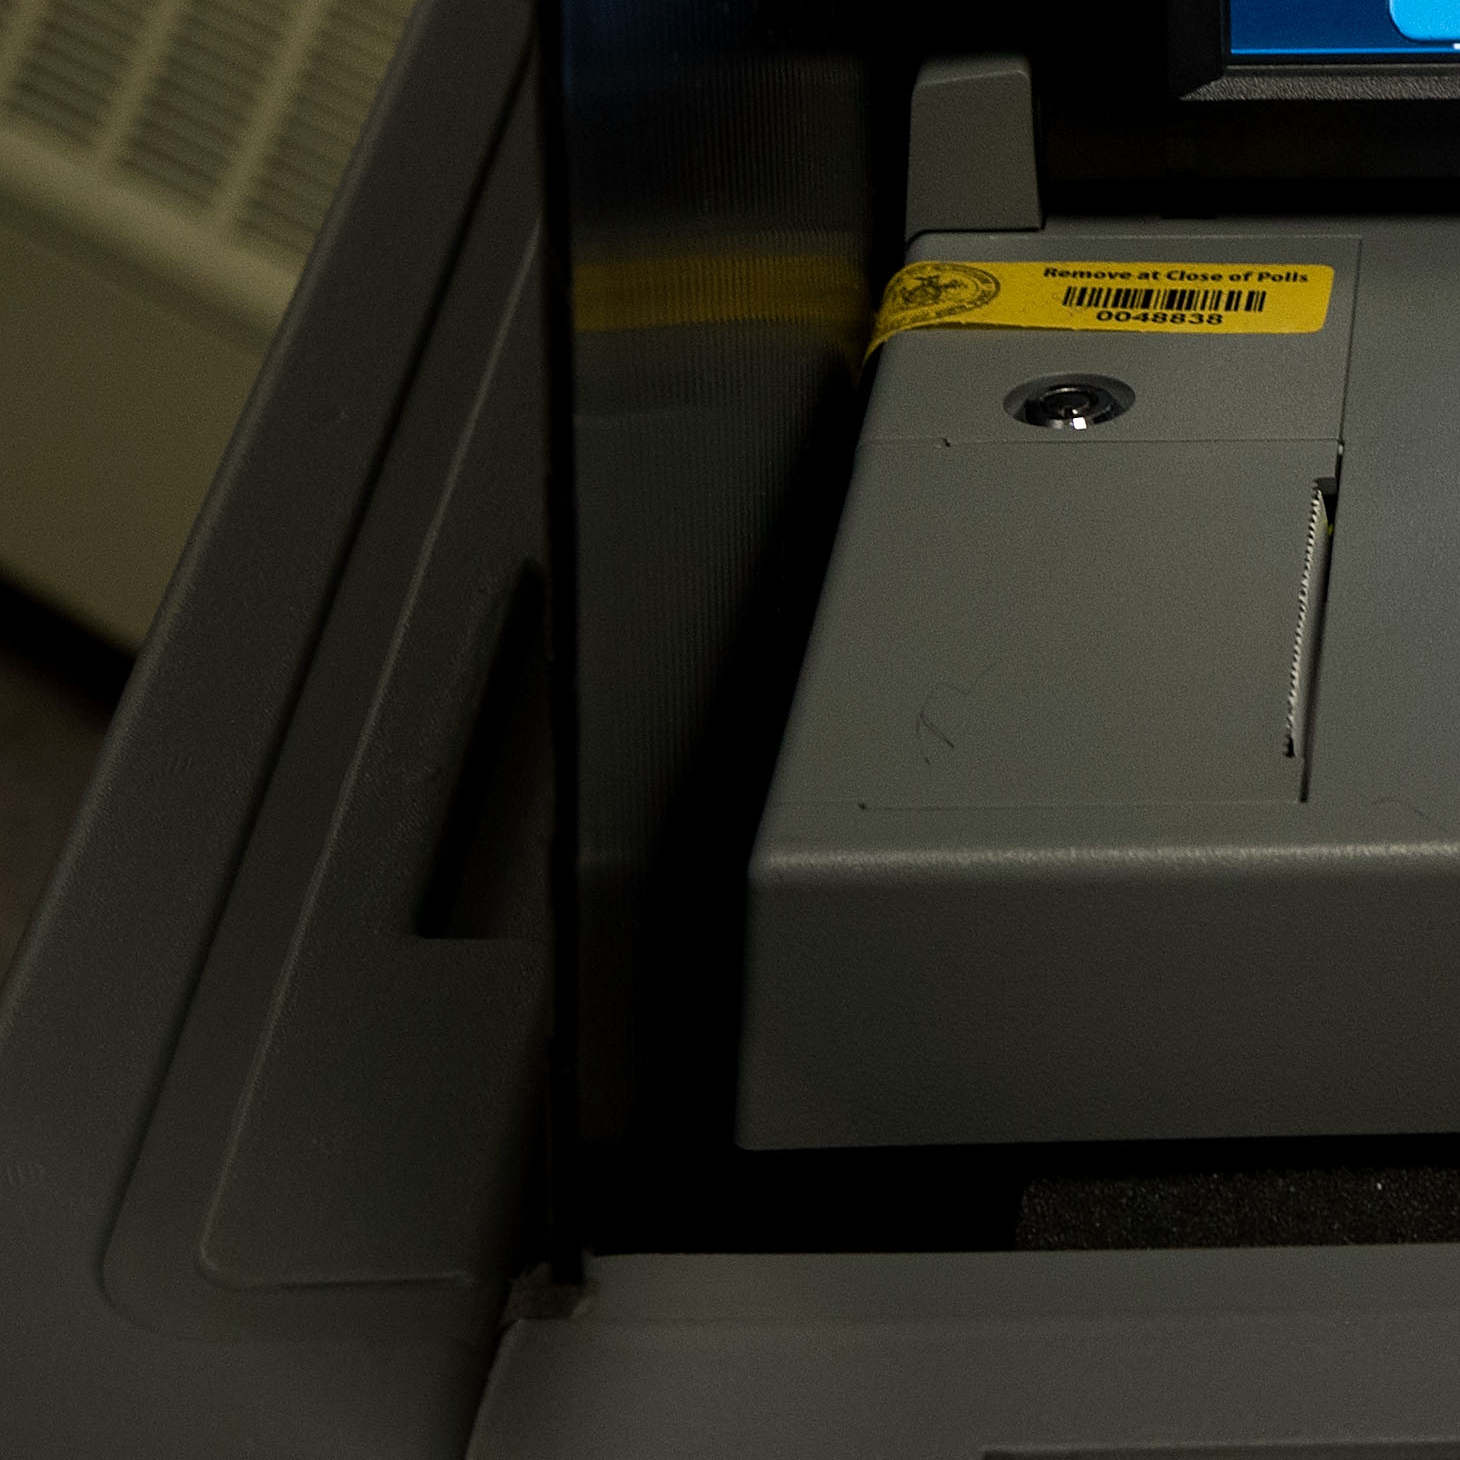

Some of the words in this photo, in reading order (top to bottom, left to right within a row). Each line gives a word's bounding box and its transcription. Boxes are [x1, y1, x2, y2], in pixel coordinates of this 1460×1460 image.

[1043, 266, 1132, 281] Remove
[1138, 270, 1160, 281] at
[1166, 270, 1224, 282] Close
[1229, 271, 1254, 283] of
[1257, 271, 1309, 284] Polls
[1096, 310, 1224, 326] 0048838
